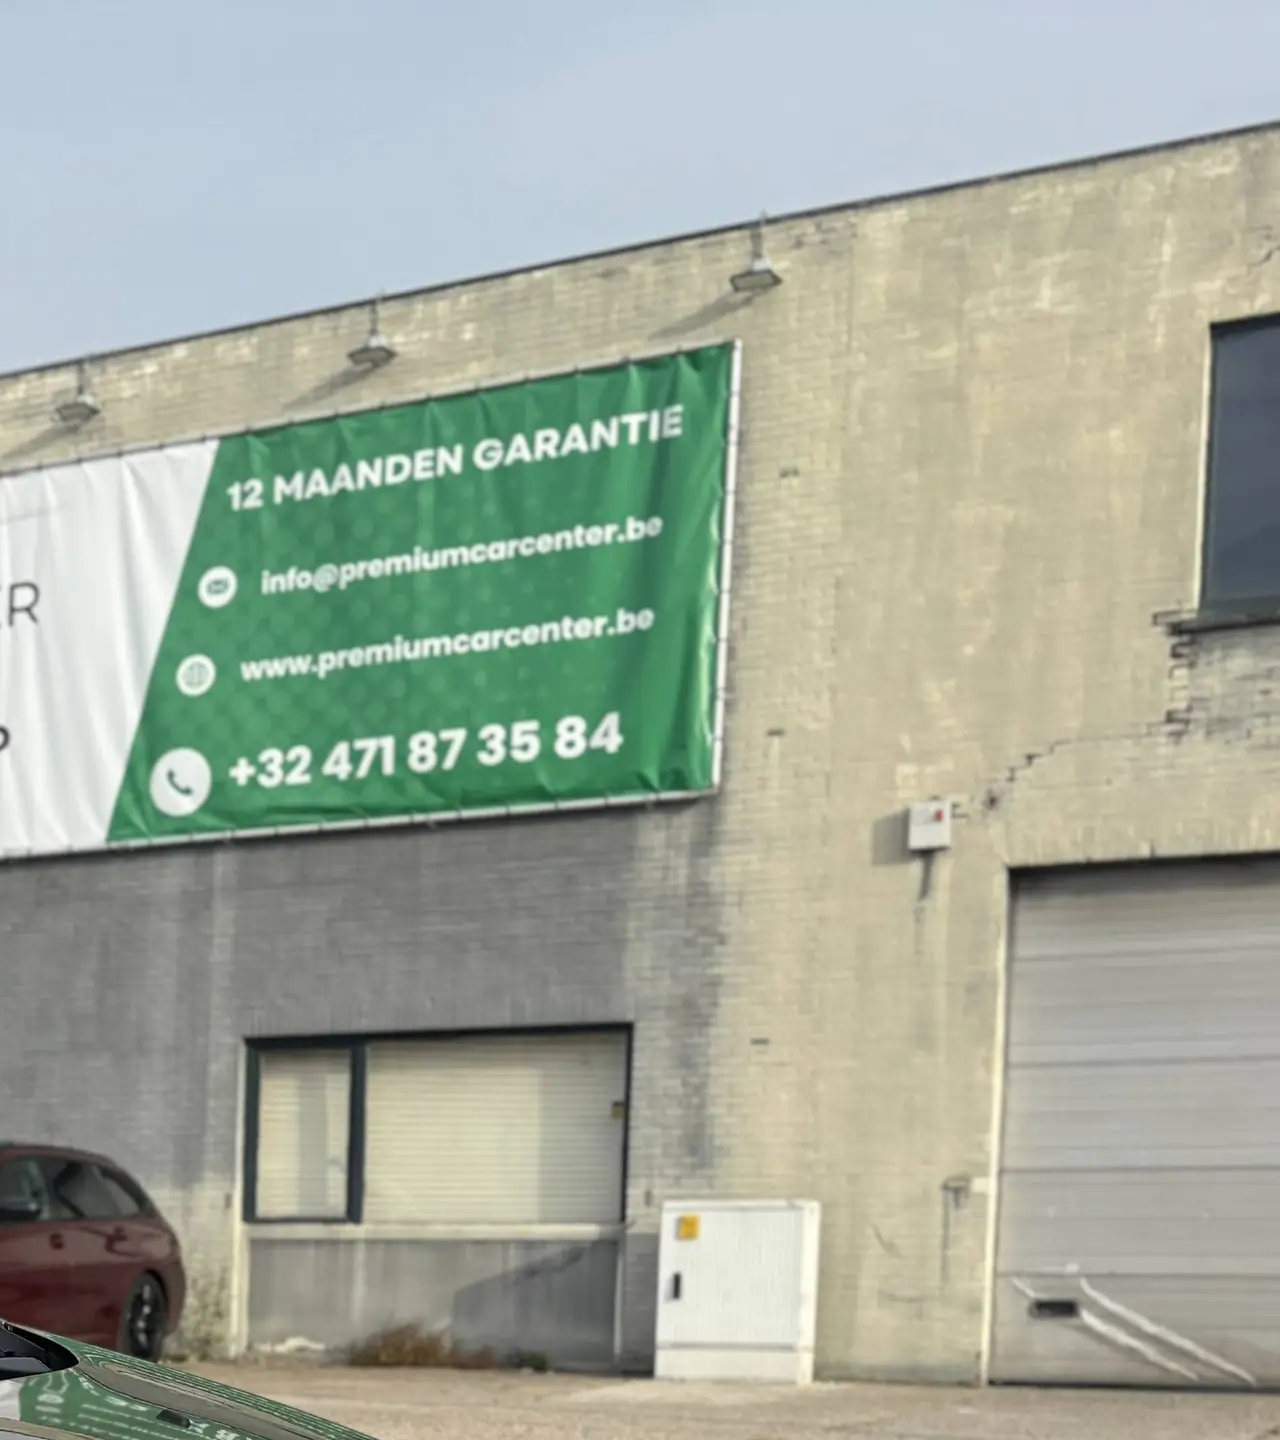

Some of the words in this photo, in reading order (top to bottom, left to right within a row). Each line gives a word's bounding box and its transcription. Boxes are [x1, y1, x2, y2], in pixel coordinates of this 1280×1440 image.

[226, 477, 264, 512] 12
[272, 443, 464, 504] MAANDEN
[472, 403, 685, 470] GARANTIE
[260, 515, 664, 595] info@premiumcarcenter.be
[239, 607, 656, 682] www.premiumcarcenter.be
[228, 745, 313, 789] +32
[322, 735, 396, 781] 471
[407, 728, 468, 774] 87
[476, 720, 542, 766] 35
[554, 711, 624, 760] 84
